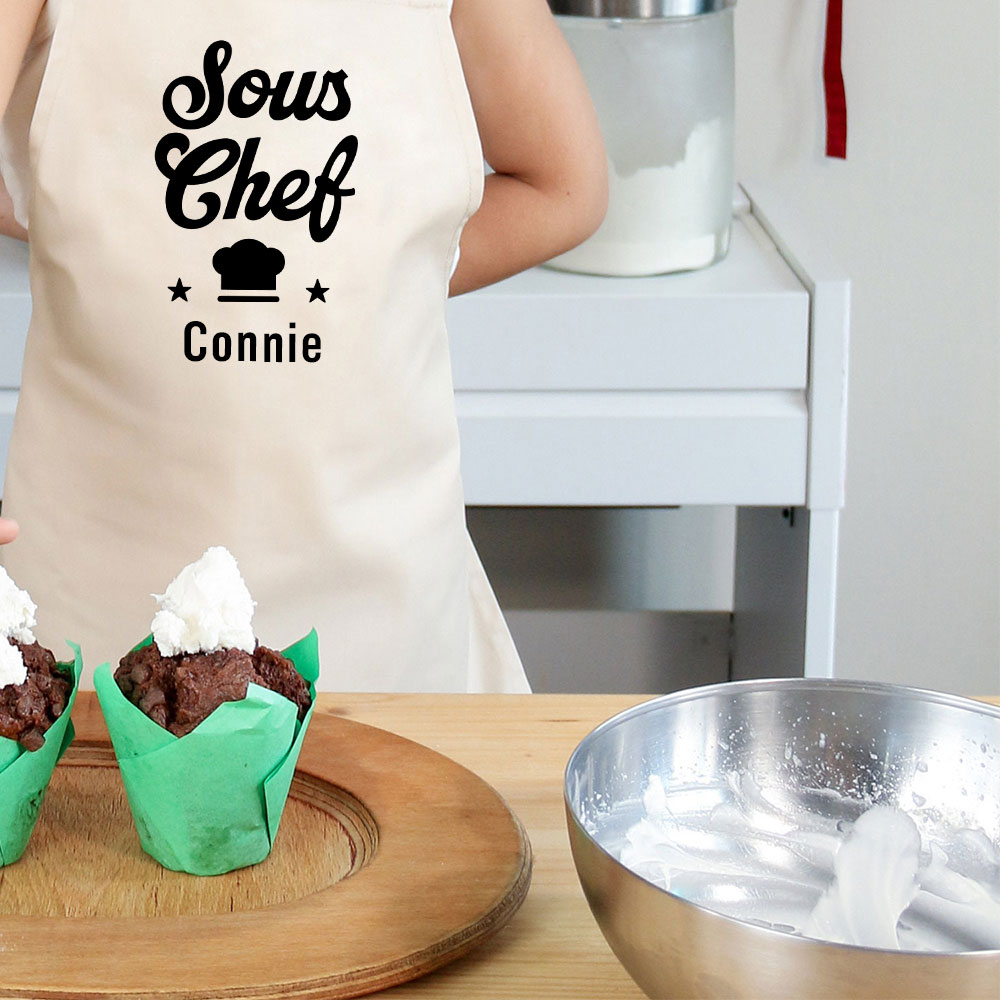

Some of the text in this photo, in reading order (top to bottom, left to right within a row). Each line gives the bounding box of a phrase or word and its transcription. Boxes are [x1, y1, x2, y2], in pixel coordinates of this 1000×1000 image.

[162, 39, 352, 130] Sous
[154, 132, 359, 243] Chef
[184, 320, 322, 363] Connie
